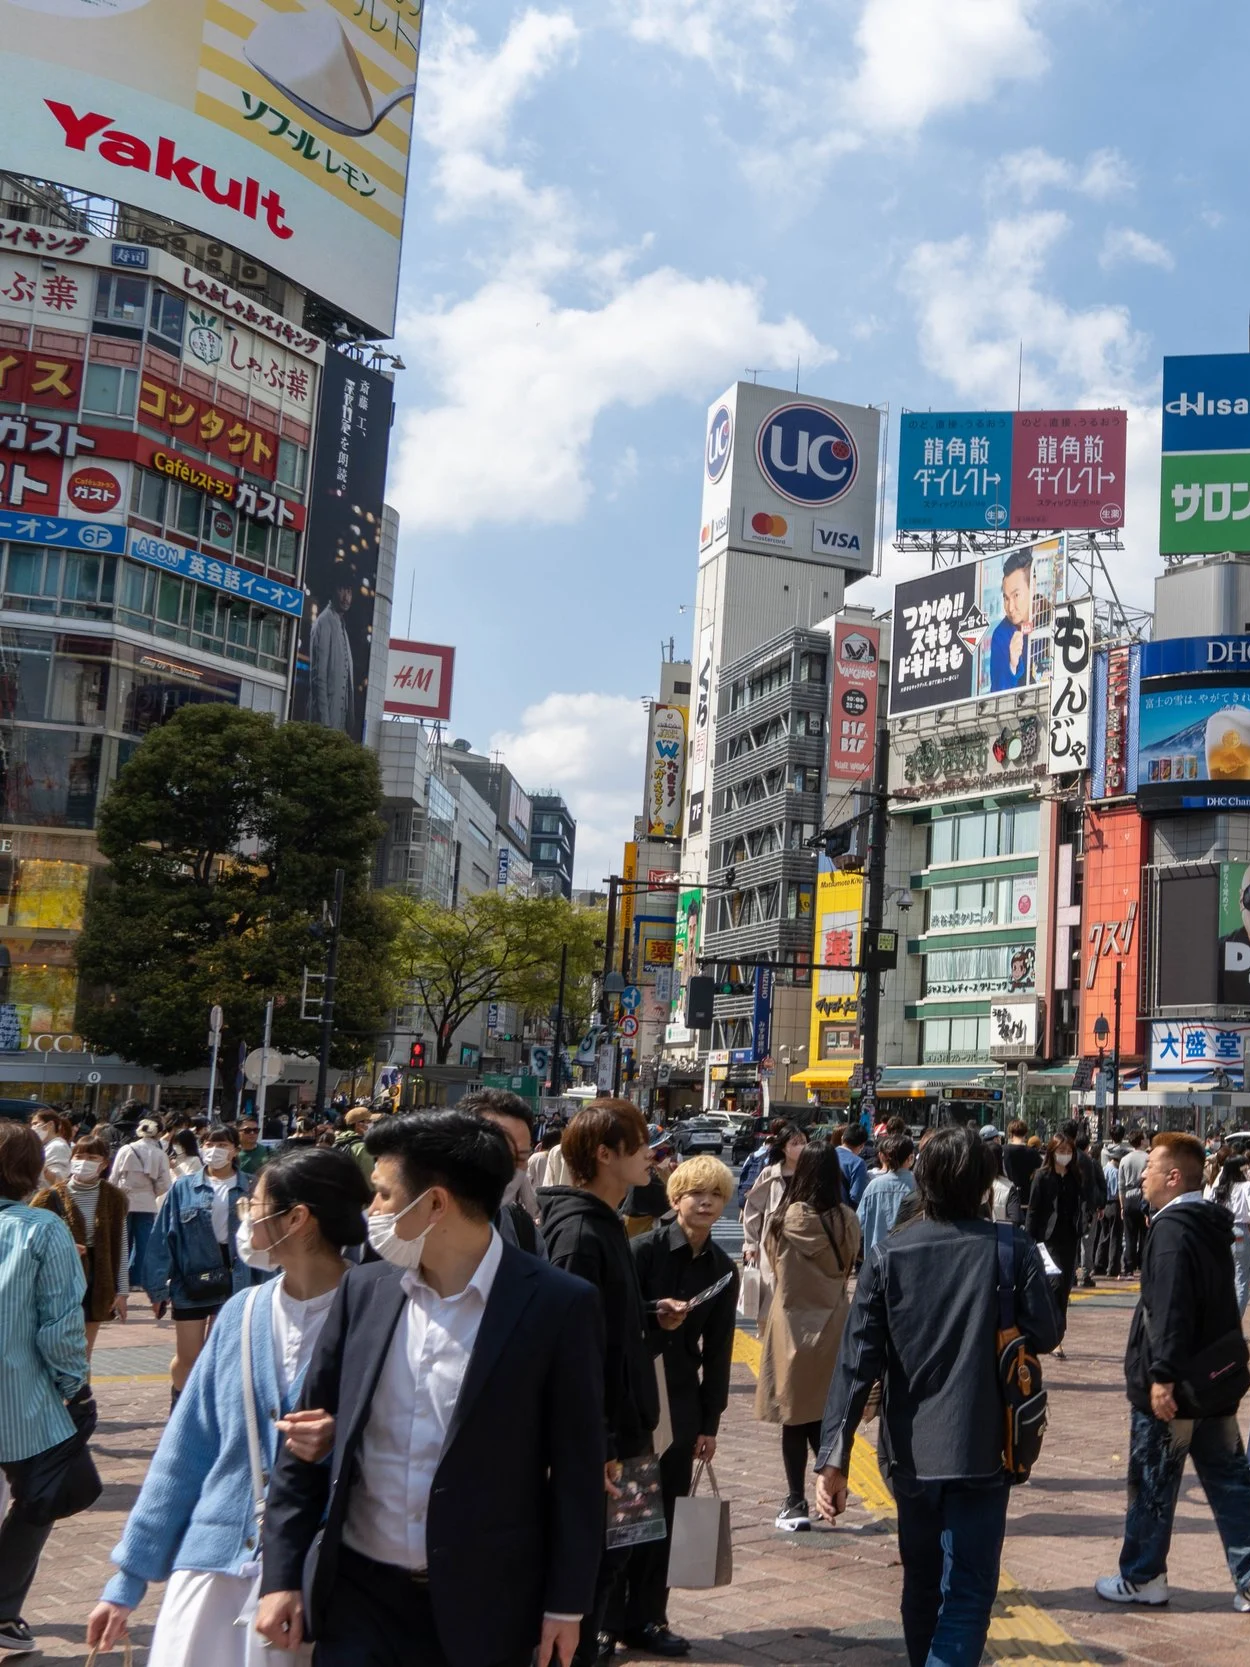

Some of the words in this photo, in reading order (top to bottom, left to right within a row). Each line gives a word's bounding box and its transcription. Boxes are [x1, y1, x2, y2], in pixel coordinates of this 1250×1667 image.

[241, 91, 320, 161] ソフール
[326, 149, 377, 197] レモン
[43, 98, 294, 240] Yakult
[0, 223, 90, 255] イキング
[116, 248, 145, 265] 寿司
[1, 271, 78, 311] ぶ葉
[183, 266, 320, 355] しゃぶしゃぶバイキング
[230, 335, 308, 402] しゃぶ葉
[0, 415, 95, 457] ガスト
[139, 380, 273, 464] コンタクト
[708, 420, 729, 465] UC
[770, 424, 848, 482] UC
[924, 436, 990, 466] 龍角散
[1037, 435, 1104, 464] 龍角散
[74, 486, 116, 502] ガスト
[154, 452, 233, 499] Caféレストラン
[235, 482, 295, 526] ガスト
[913, 468, 1001, 497] ダイレクト
[1027, 467, 1116, 495] ダイレクト
[715, 516, 726, 532] VISA
[986, 509, 1005, 521] 生薬
[1101, 509, 1120, 520] 生薬
[83, 527, 109, 545] 6F
[752, 535, 785, 545] mastercard
[816, 528, 861, 551] VISA
[137, 537, 180, 566] AEON
[188, 553, 300, 609] 英会話イーオン
[910, 621, 952, 654] スキも
[898, 644, 965, 683] ドキドキも
[393, 665, 434, 692] H&M
[1050, 604, 1089, 766] もんじゃ
[841, 720, 866, 736] B1F
[840, 737, 866, 753] B2F
[692, 802, 702, 821] 7F
[1207, 797, 1227, 807] DHC
[499, 858, 507, 885] LABI
[820, 879, 850, 889] Matsumoto
[651, 941, 673, 961] 薬
[825, 928, 854, 966] 薬
[1086, 901, 1137, 989] クスリ
